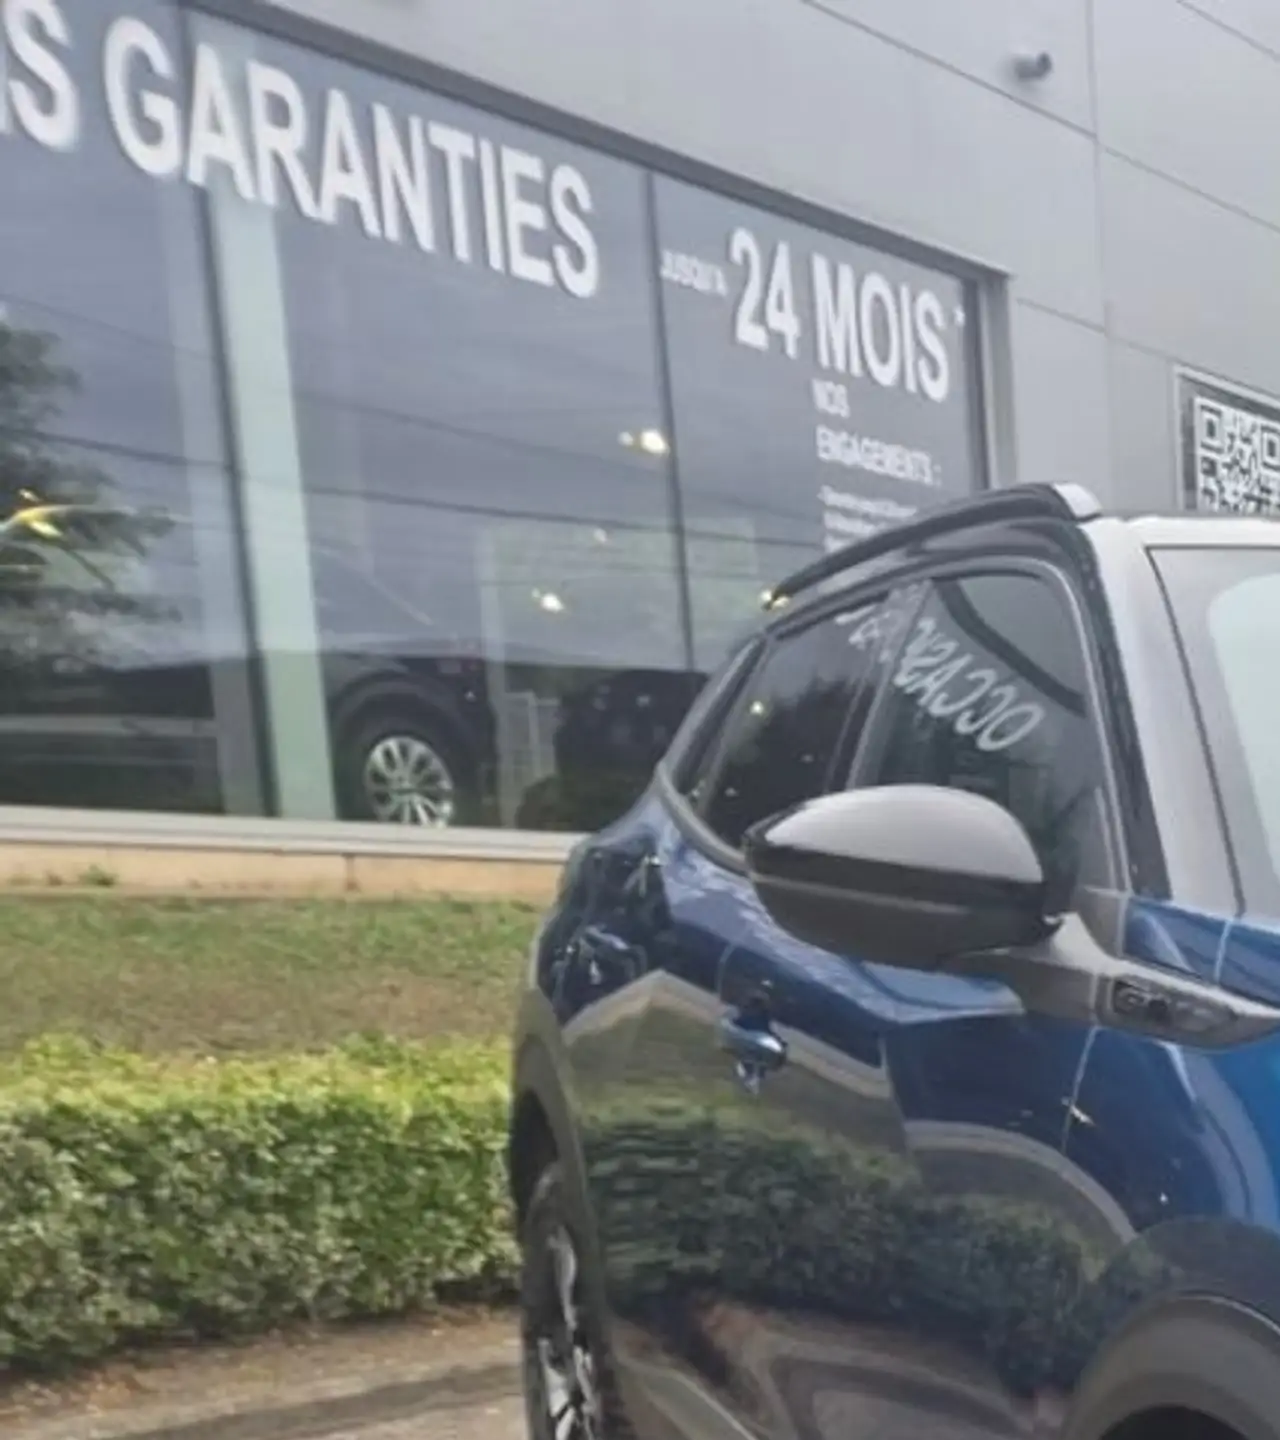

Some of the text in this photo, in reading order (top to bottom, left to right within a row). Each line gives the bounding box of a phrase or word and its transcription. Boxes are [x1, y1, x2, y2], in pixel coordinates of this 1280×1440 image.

[0, 0, 600, 299] S GARANTIES
[731, 227, 800, 360] 24
